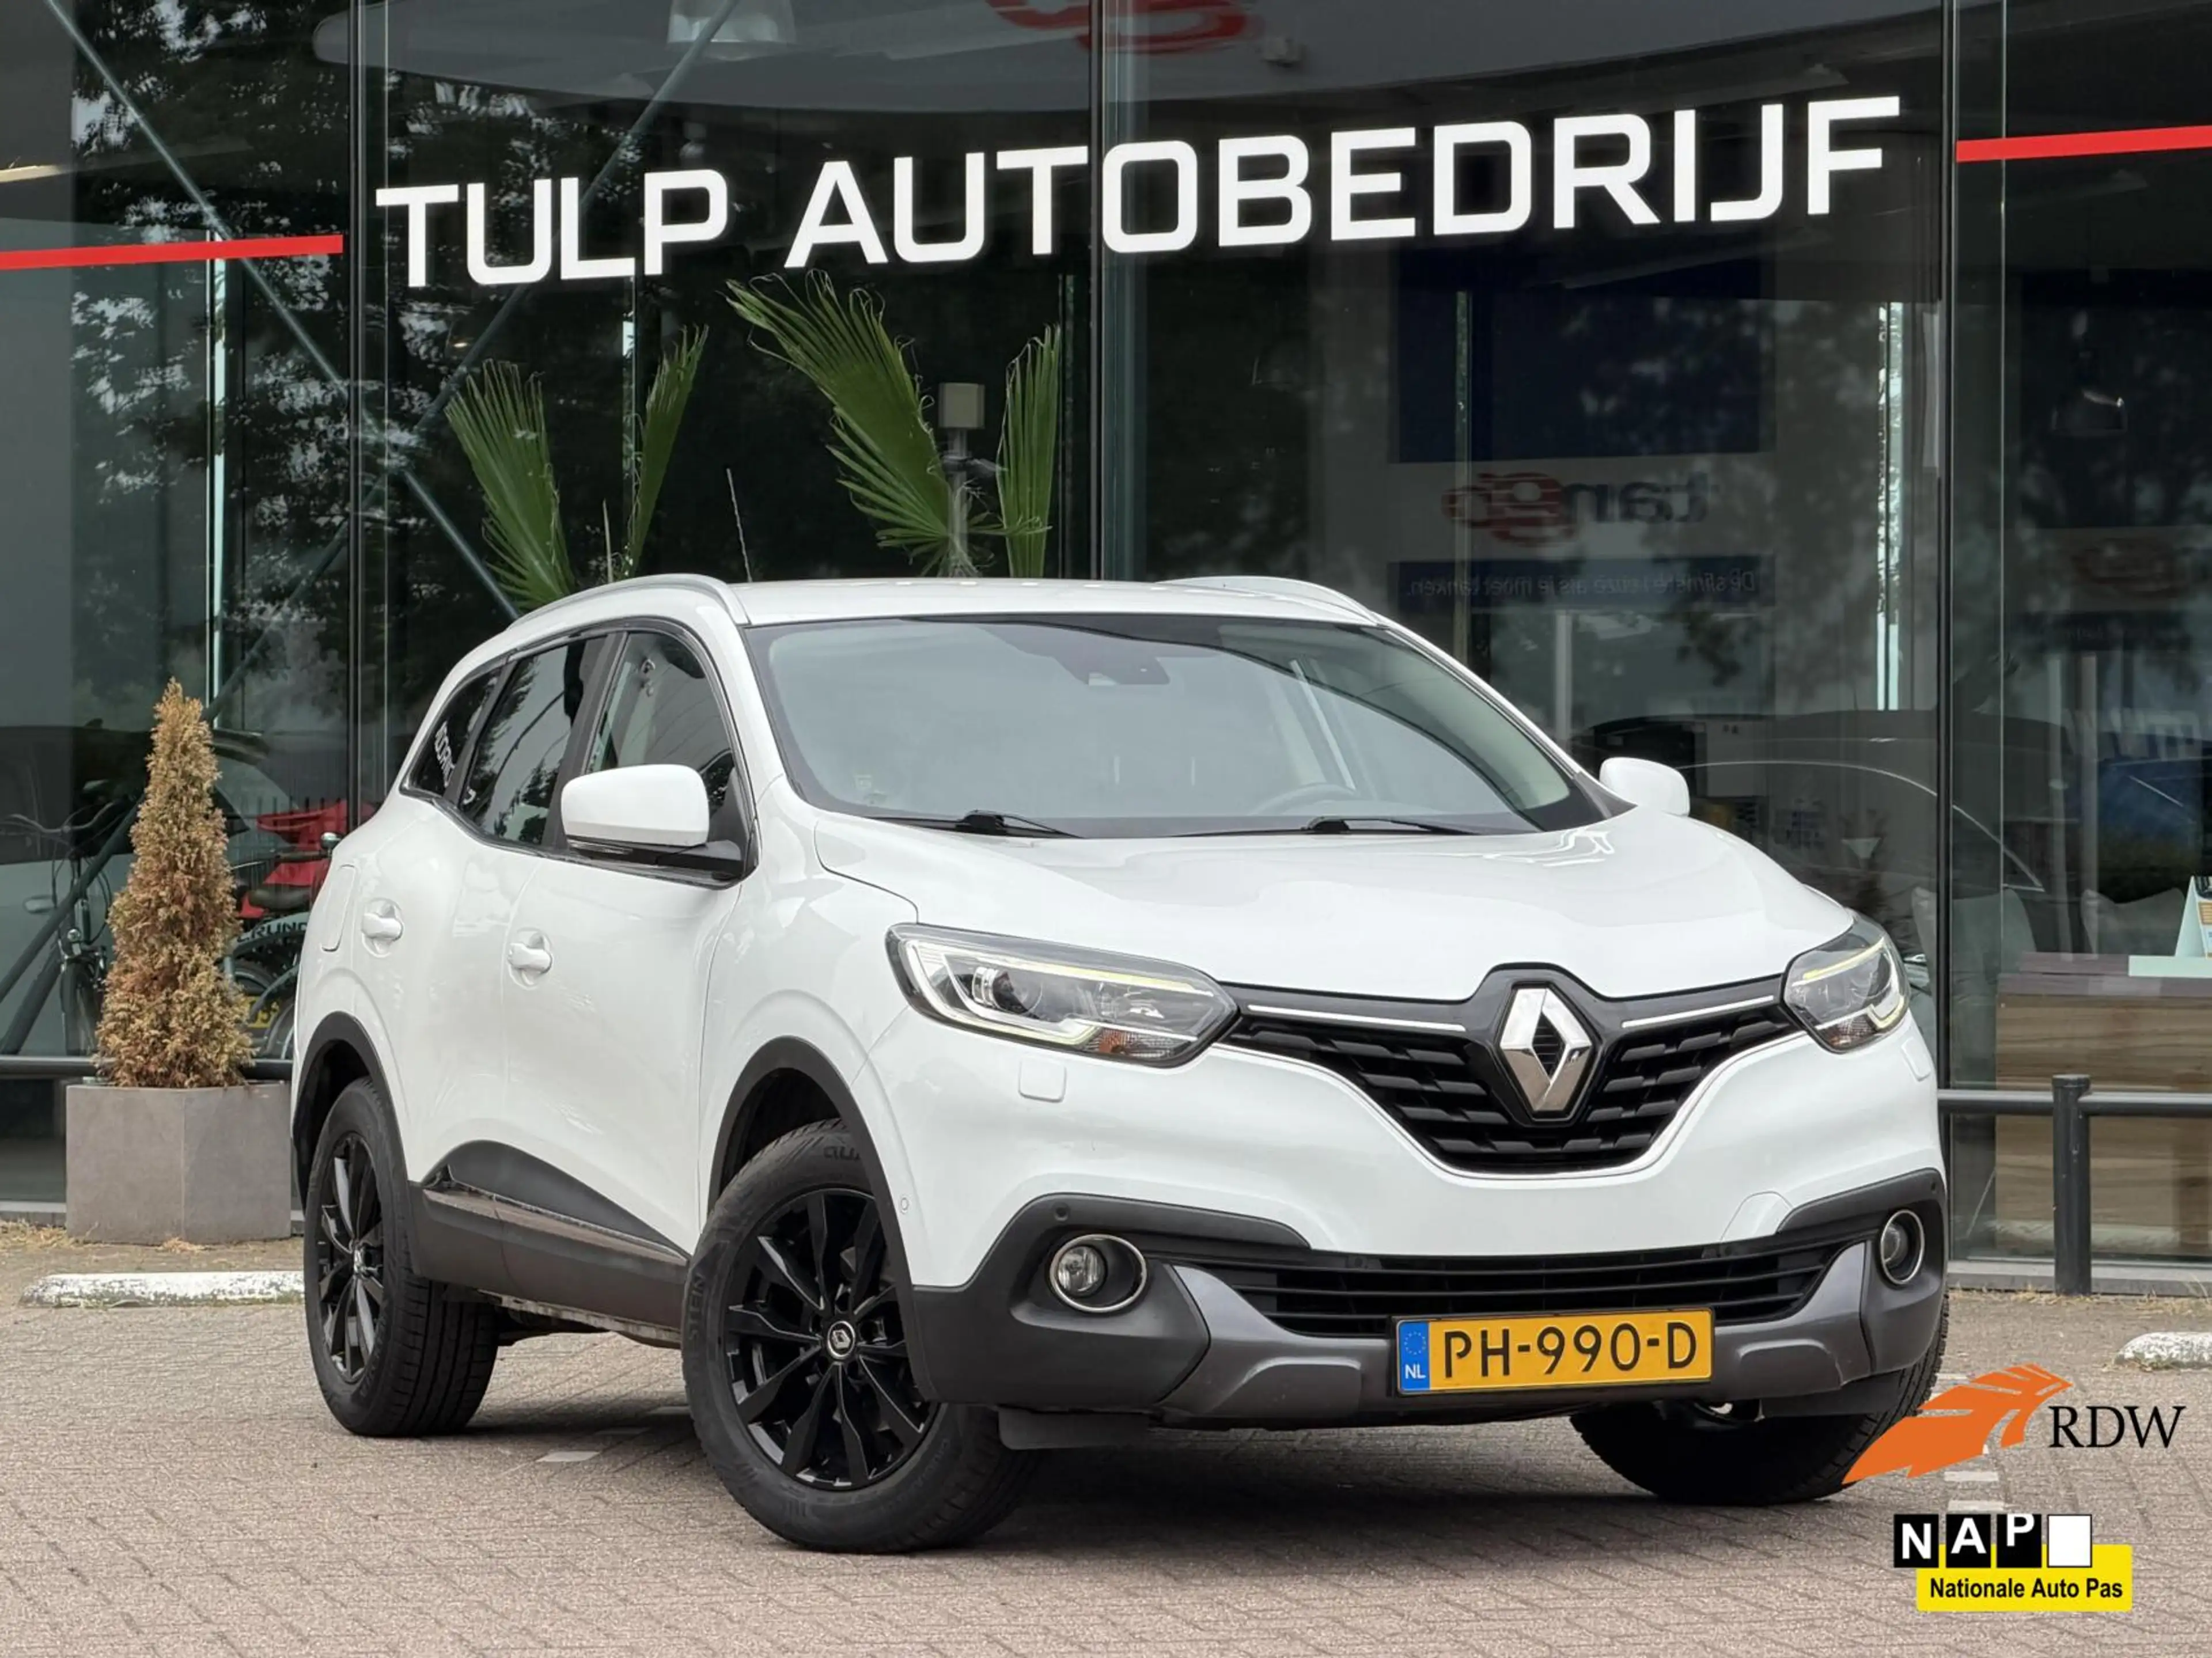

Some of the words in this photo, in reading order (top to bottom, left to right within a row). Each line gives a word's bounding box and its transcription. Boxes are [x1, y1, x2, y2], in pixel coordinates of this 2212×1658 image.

[376, 169, 728, 287] TULP
[784, 96, 1900, 268] AUTOBEDRIJF
[1405, 1364, 1426, 1379] NL
[1444, 1321, 1697, 1378] PH-990-D
